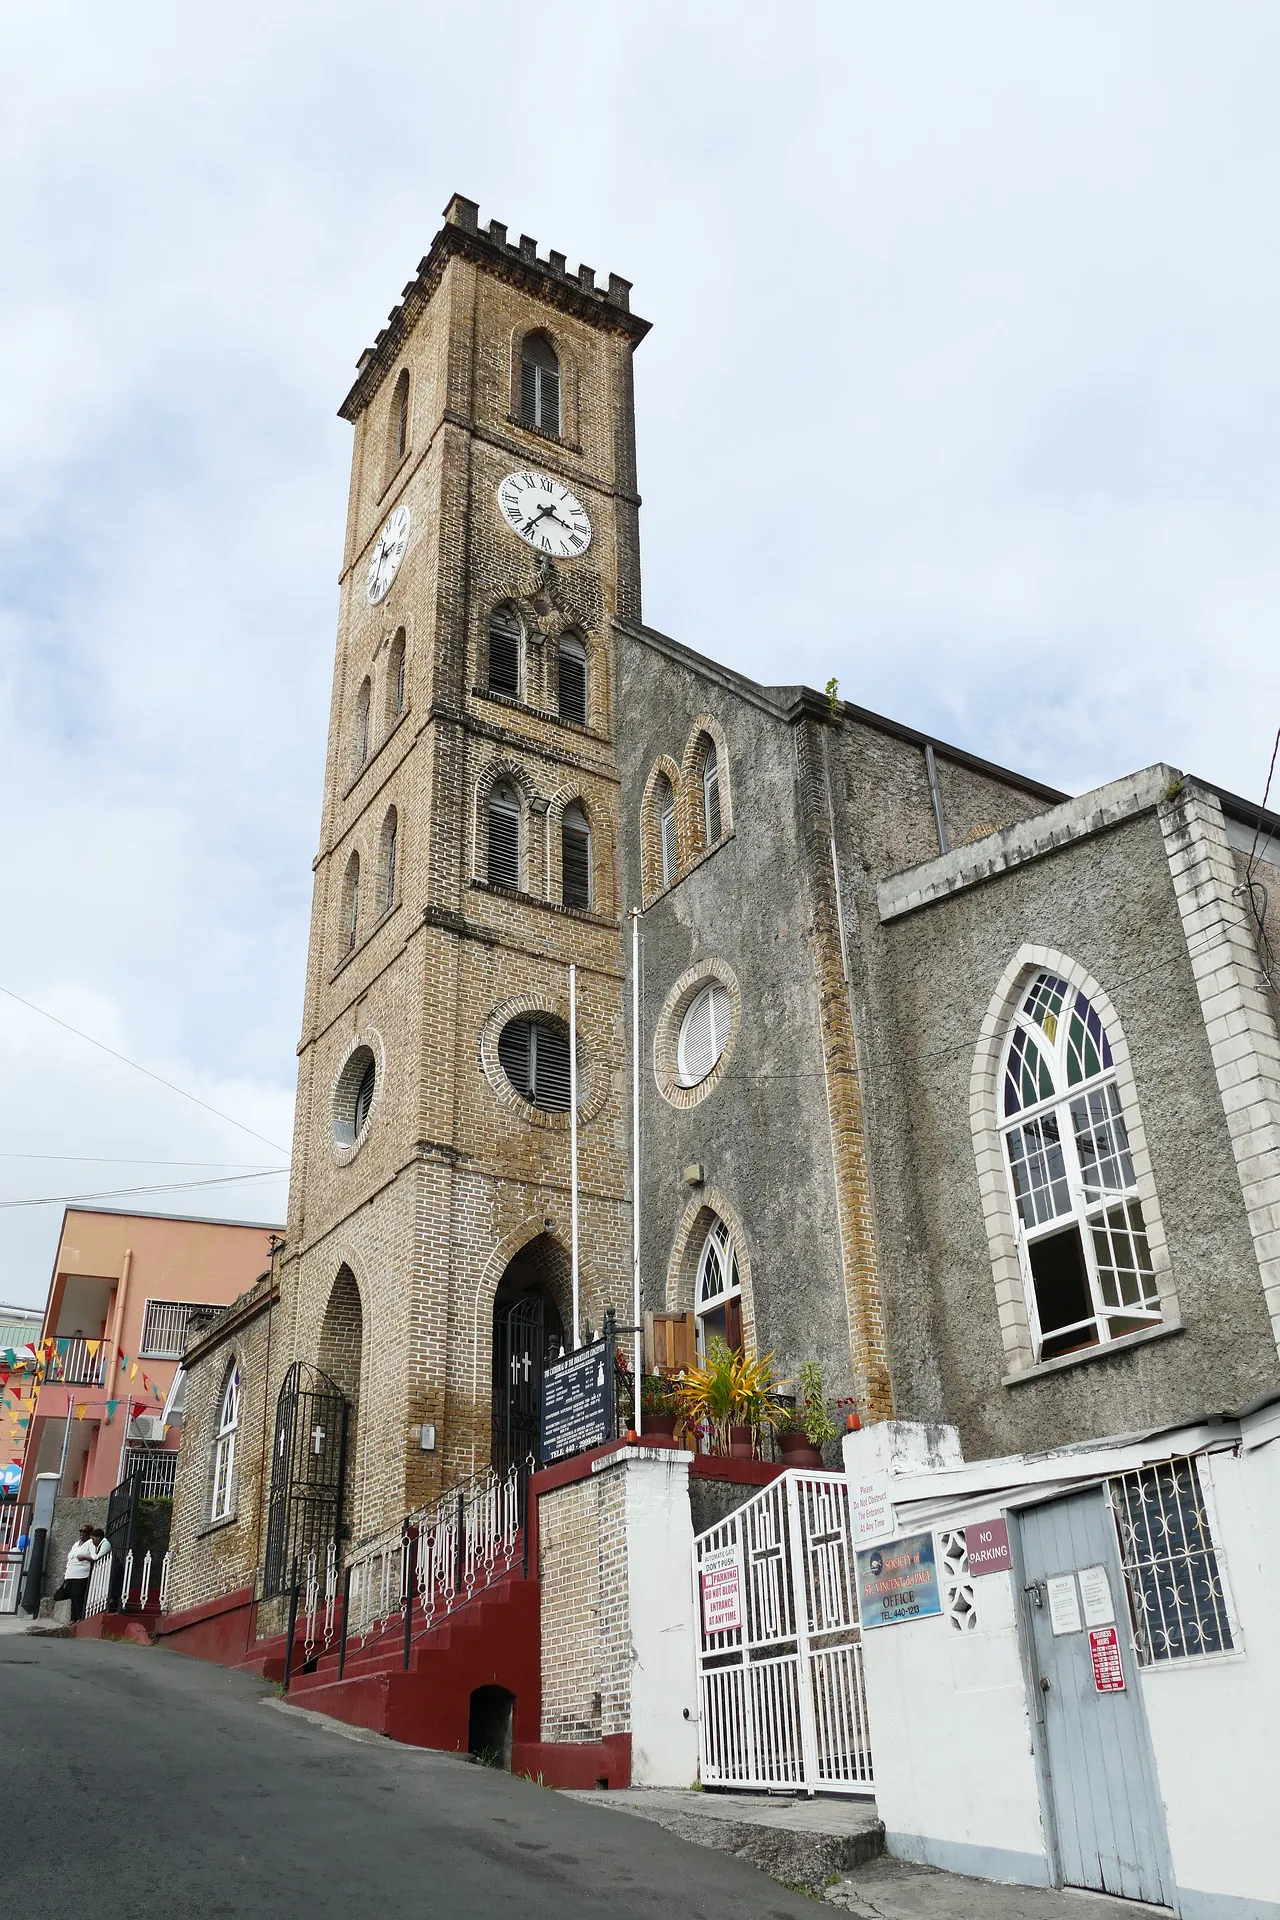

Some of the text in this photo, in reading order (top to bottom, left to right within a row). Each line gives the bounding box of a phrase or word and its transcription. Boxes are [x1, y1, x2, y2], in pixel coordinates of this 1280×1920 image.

[510, 480, 523, 493] X
[540, 478, 553, 494] XII
[860, 1485, 873, 1495] Please
[868, 1492, 886, 1504] Obstruct
[866, 1507, 884, 1518] Entrance
[874, 1520, 884, 1528] Time
[980, 1531, 992, 1544] NO
[705, 1548, 734, 1562] AUTOMATIC GATE
[884, 1552, 920, 1570] SOCIETY of
[970, 1545, 1008, 1564] PARKING
[706, 1559, 734, 1571] DON'T PUSH
[714, 1569, 736, 1583] PARKING
[864, 1570, 932, 1596] ST. VINCENT de PAUL
[705, 1583, 737, 1600] DO NOT BLOCK
[710, 1598, 733, 1612] ENTRANCE
[883, 1590, 915, 1609] OFFICE
[709, 1611, 736, 1626] AT ANY TIME
[880, 1606, 920, 1621] TEL: 440-1213
[1093, 1630, 1111, 1639] BUSINESS
